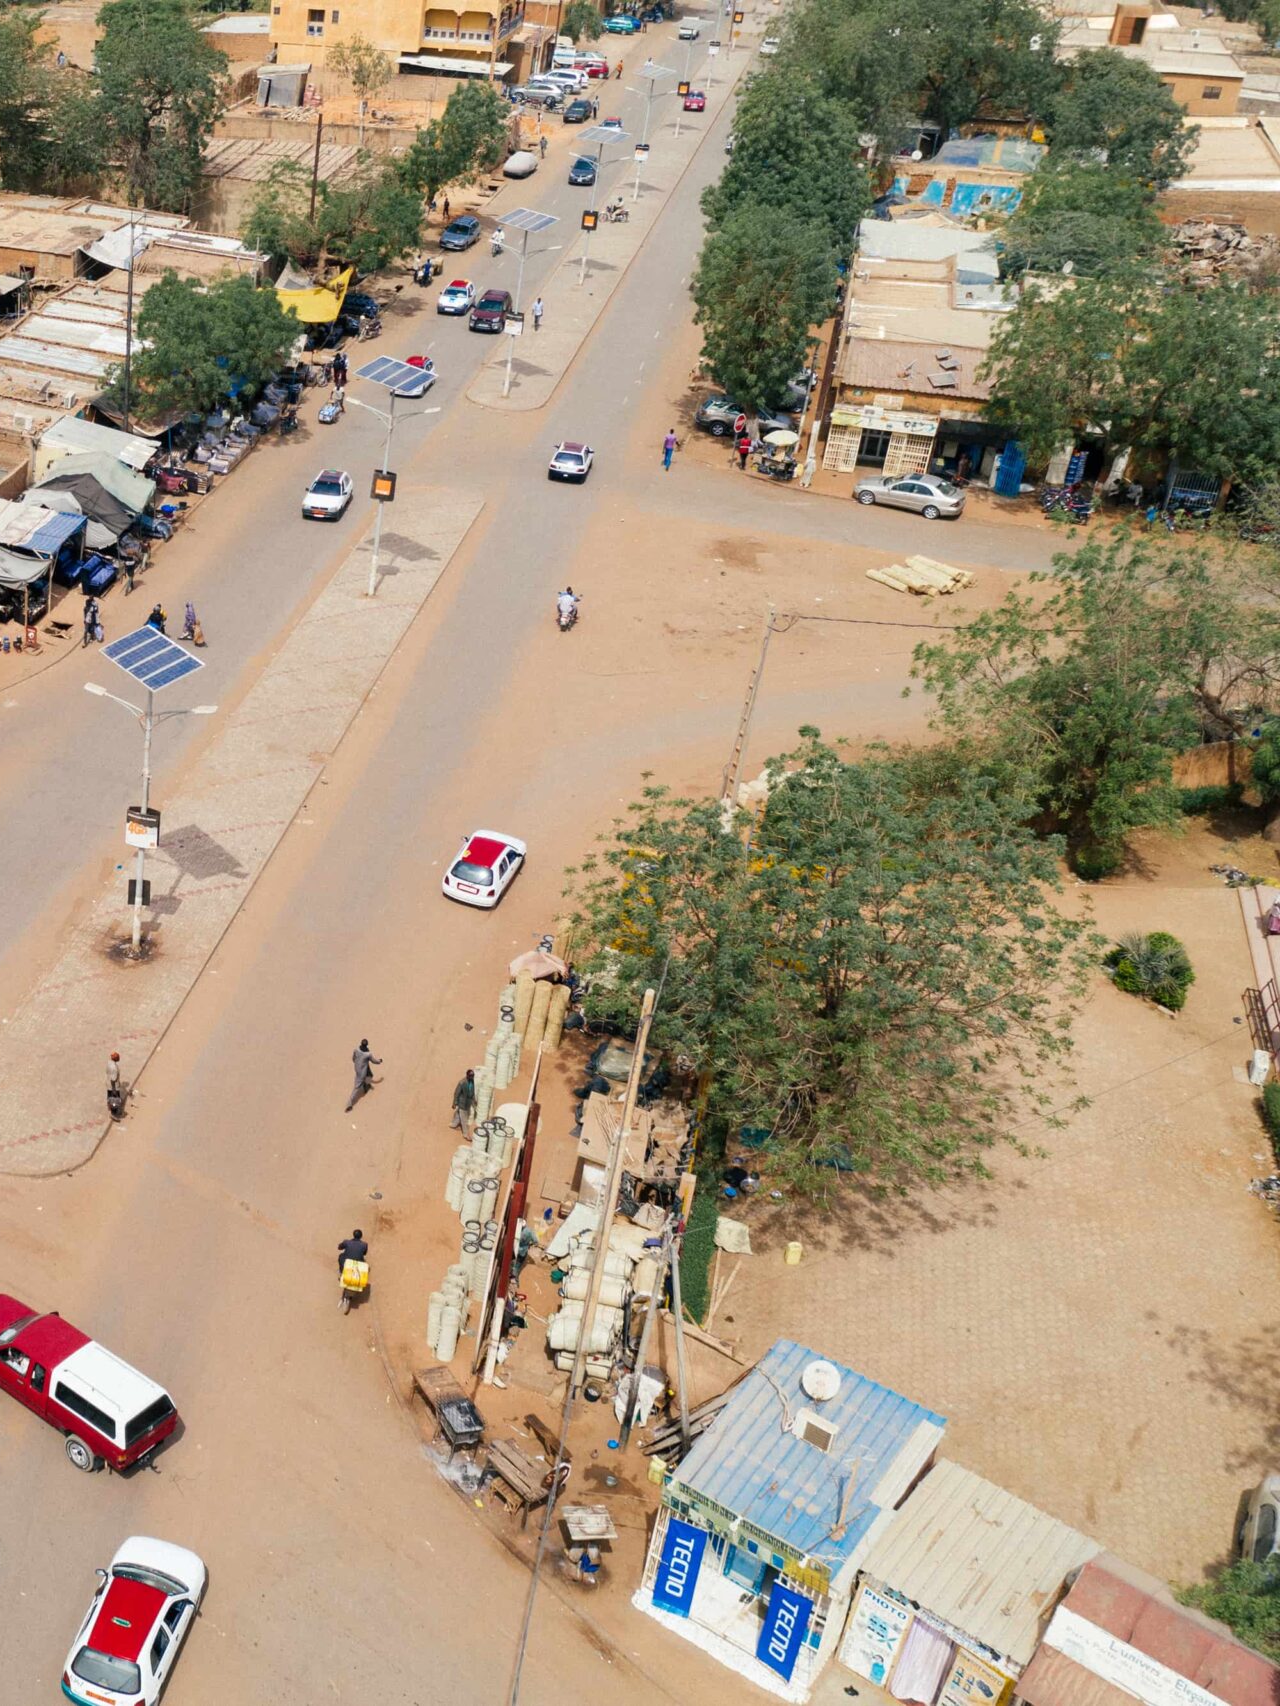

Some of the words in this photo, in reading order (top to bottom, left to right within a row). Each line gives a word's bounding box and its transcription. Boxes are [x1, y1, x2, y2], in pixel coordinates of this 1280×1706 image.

[664, 1536, 695, 1598] TECNO
[768, 1598, 800, 1664] TECNO
[864, 1588, 907, 1620] PHOTO
